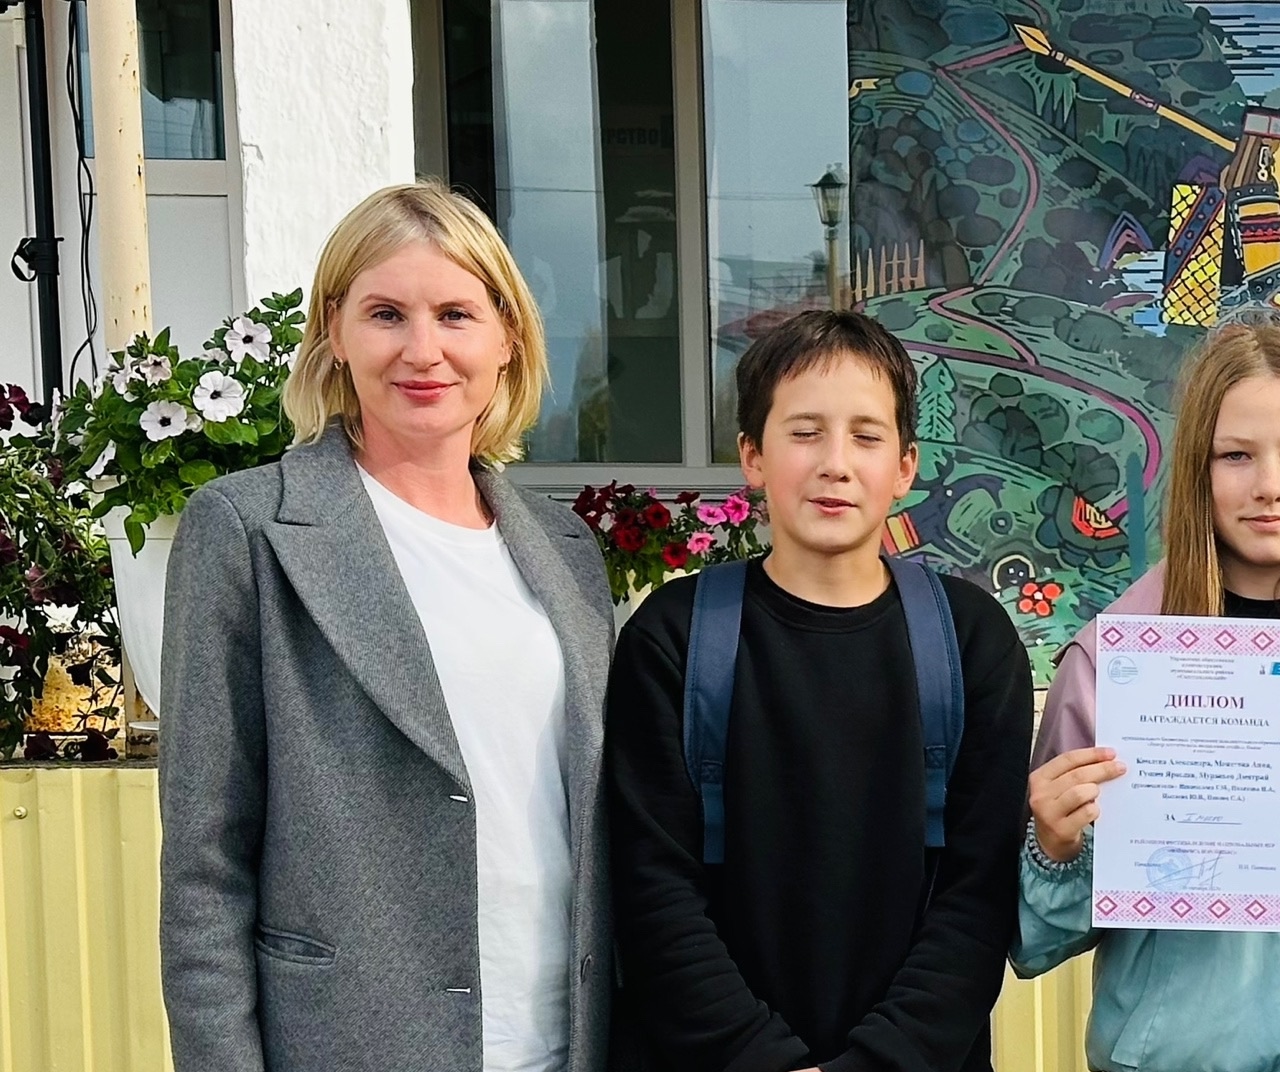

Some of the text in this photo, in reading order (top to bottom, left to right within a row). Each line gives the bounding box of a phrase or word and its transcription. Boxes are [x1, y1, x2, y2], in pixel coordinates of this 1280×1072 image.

[1164, 694, 1245, 709] ДИПЛОМ
[1139, 714, 1270, 727] НАГРАЖДАЕТСЯ КОМАНДА
